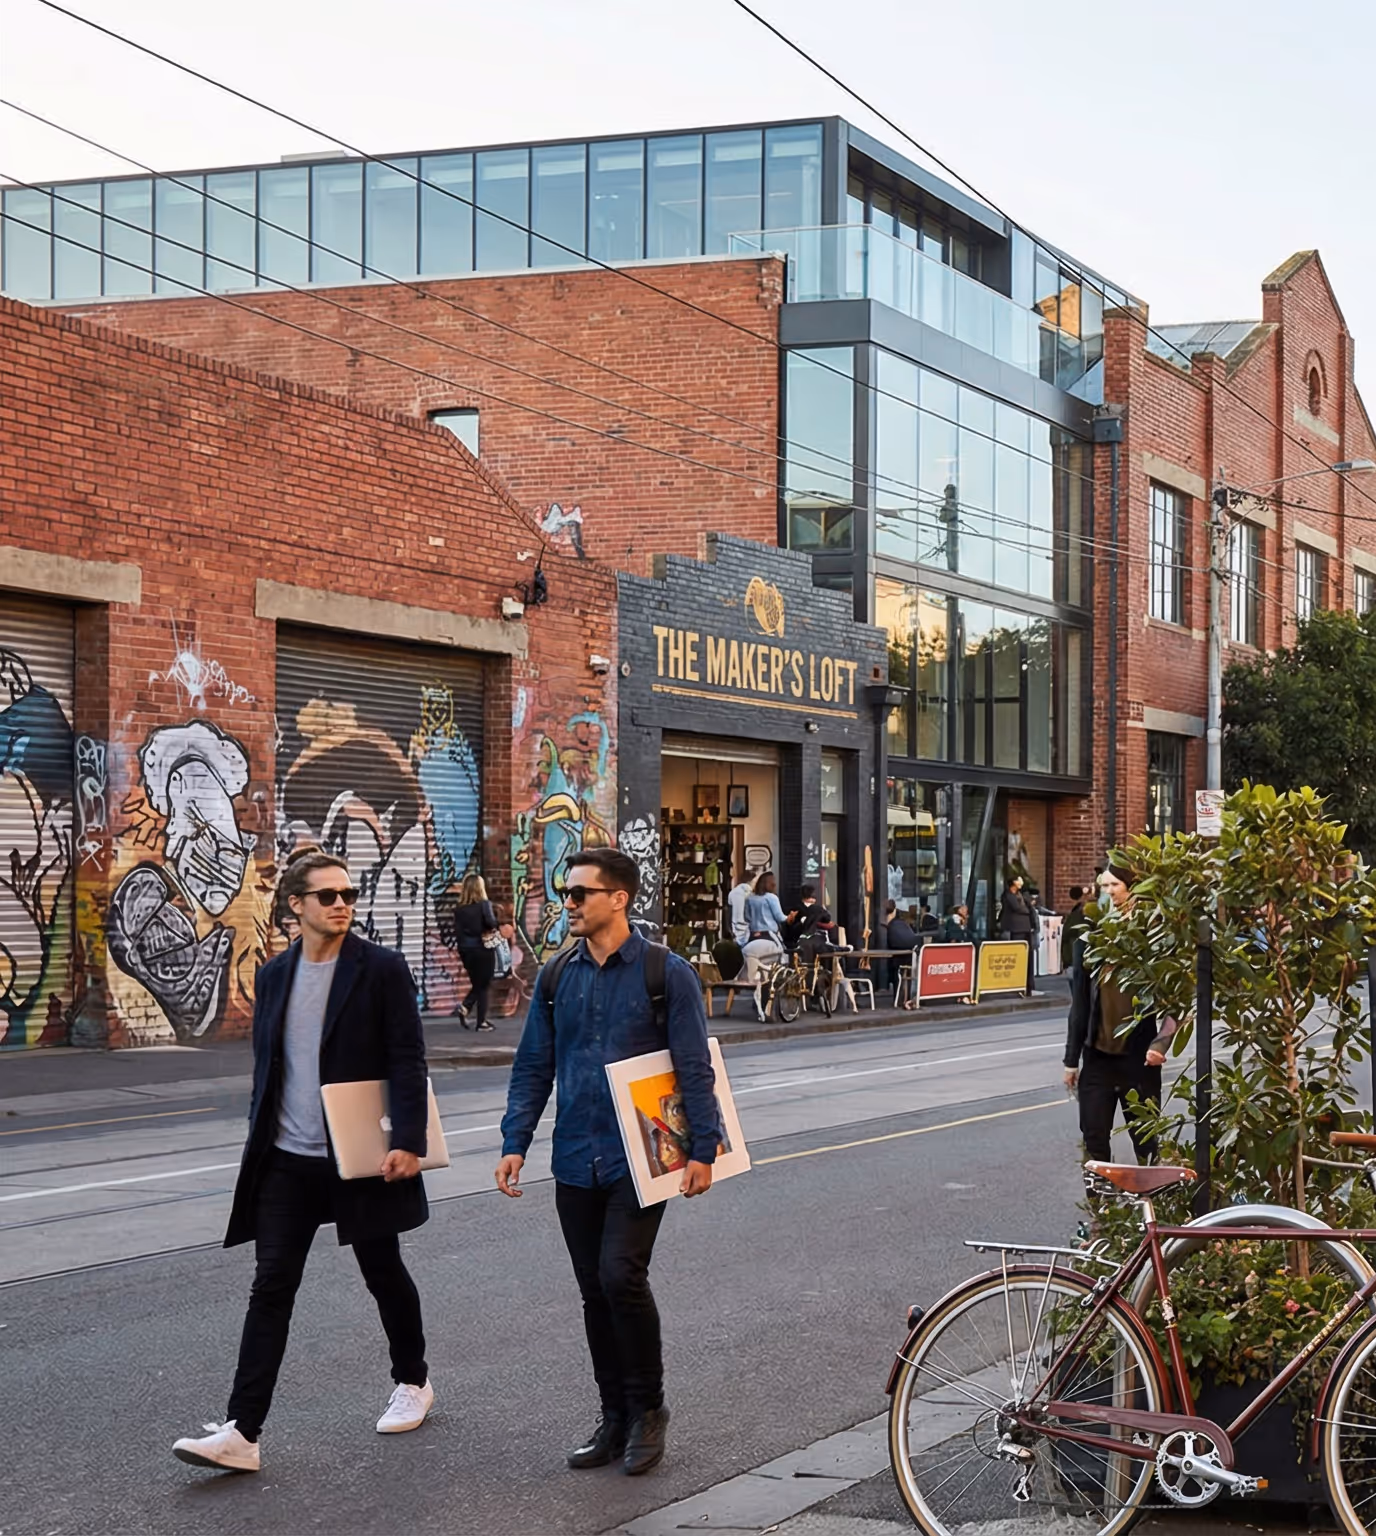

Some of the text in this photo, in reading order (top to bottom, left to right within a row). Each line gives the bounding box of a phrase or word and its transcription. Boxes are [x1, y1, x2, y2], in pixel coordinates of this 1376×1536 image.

[652, 625, 858, 705] THE MAKER'S LOFT
